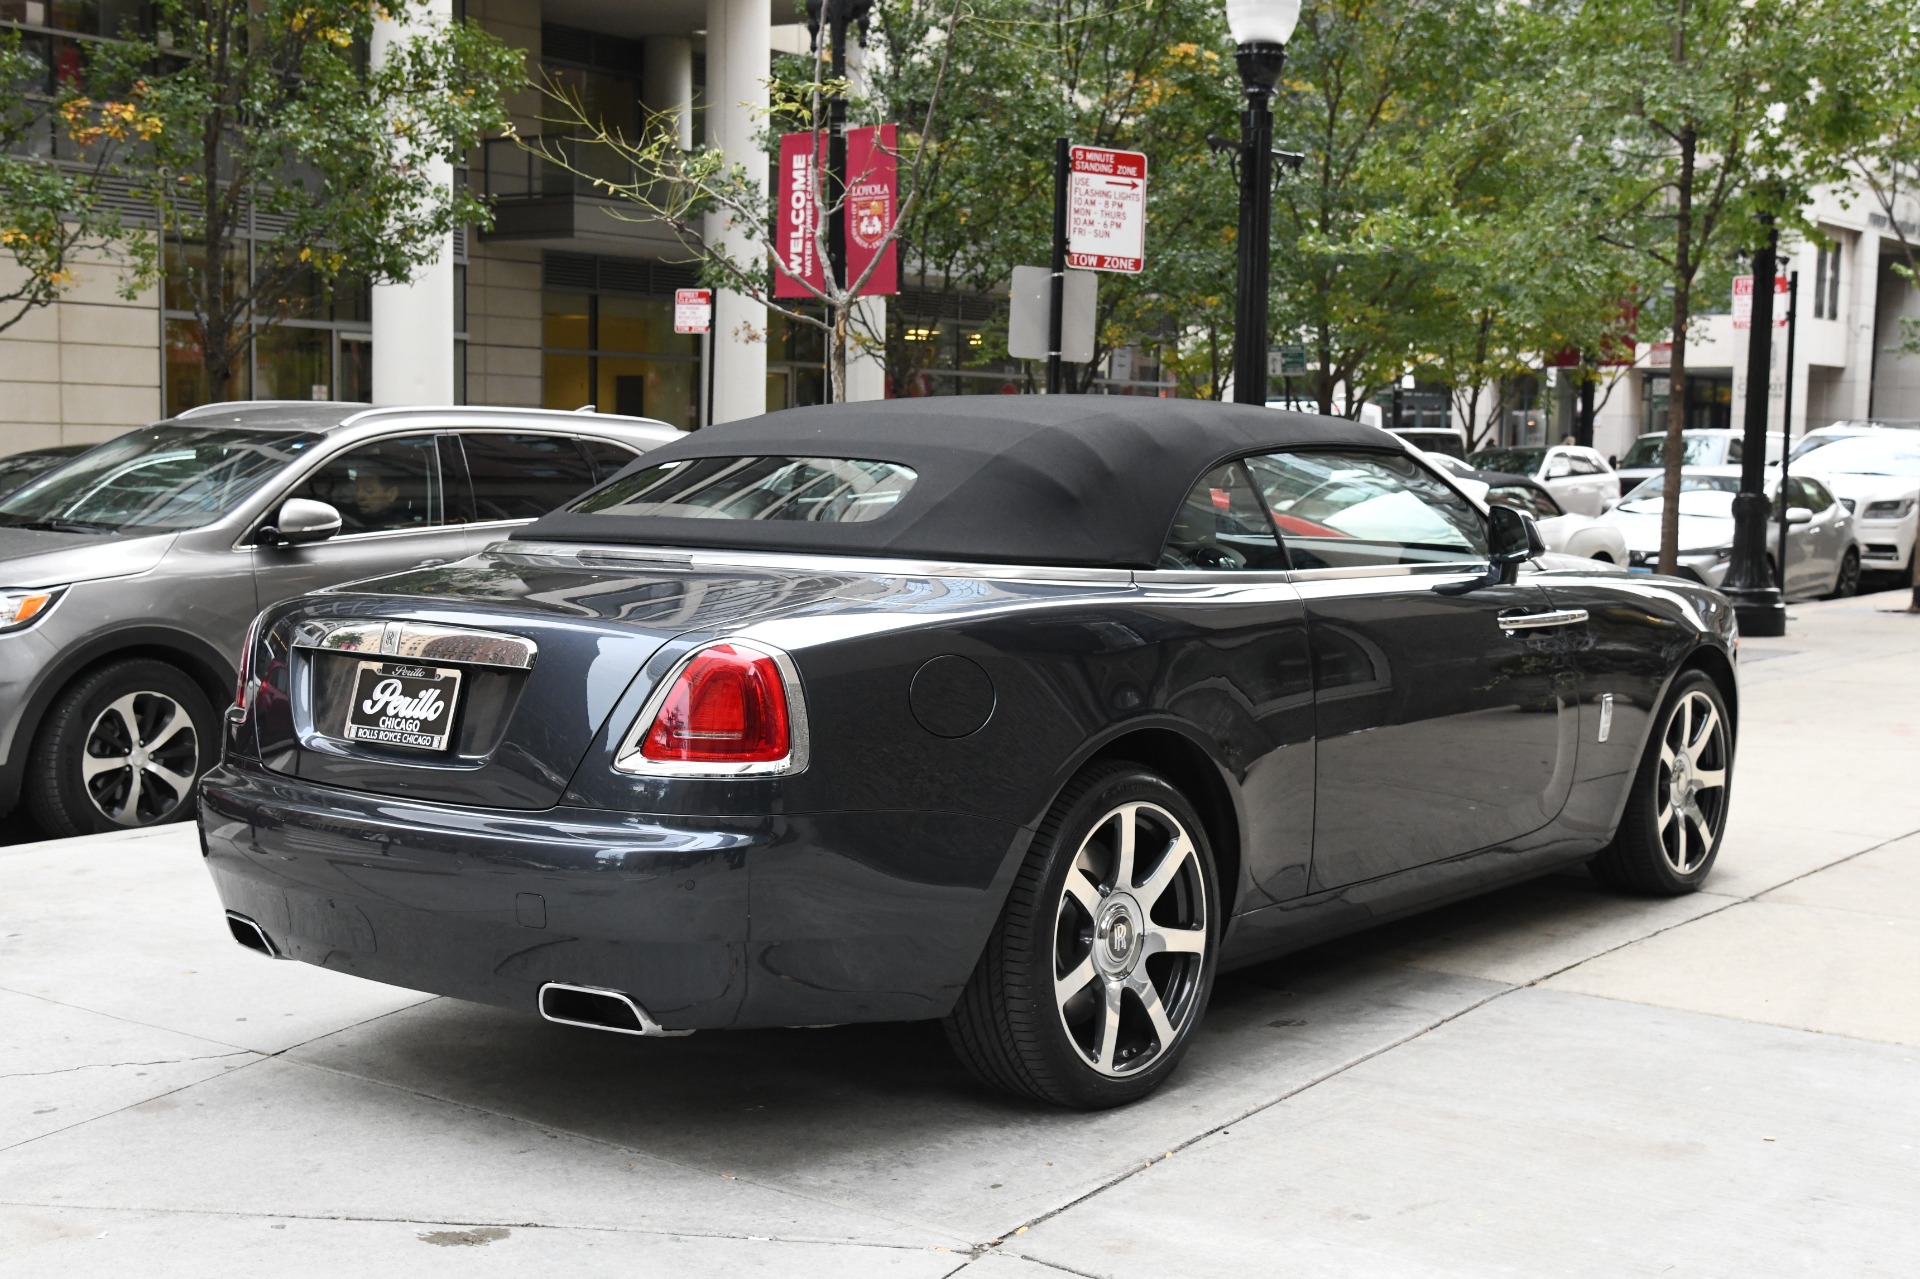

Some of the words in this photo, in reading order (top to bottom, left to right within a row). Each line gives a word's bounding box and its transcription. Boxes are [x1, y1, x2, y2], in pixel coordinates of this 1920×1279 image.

[1075, 150, 1084, 160] 15
[1086, 151, 1115, 163] MINUTE
[1075, 161, 1113, 174] STANDING
[1116, 165, 1138, 176] ZONE
[1074, 177, 1090, 187] USE
[852, 184, 889, 196] LOYOLA
[1074, 188, 1112, 199] FLASHING
[1113, 191, 1140, 202] LIGHTS
[1074, 197, 1083, 206] 10
[1084, 199, 1096, 207] AM
[1104, 200, 1109, 209] 8
[1112, 201, 1123, 209] PM
[790, 155, 806, 275] WELCOME
[805, 201, 814, 239] TOWER
[1073, 208, 1091, 216] MON
[1100, 210, 1127, 220] THURS
[1073, 217, 1081, 226] 10
[1103, 220, 1108, 229] 6
[1110, 221, 1122, 230] PM
[1072, 227, 1086, 236] FRI
[1093, 229, 1111, 239] SUN
[804, 241, 813, 277] WATER
[1072, 253, 1098, 267] TOW
[1103, 256, 1136, 270] ZONE
[392, 665, 426, 677] Perillo
[362, 678, 445, 721] Perillo
[379, 716, 421, 732] CHICAGO
[357, 728, 379, 740] ROLLS
[379, 731, 401, 742] ROYCE
[401, 734, 432, 745] CHICAGO
